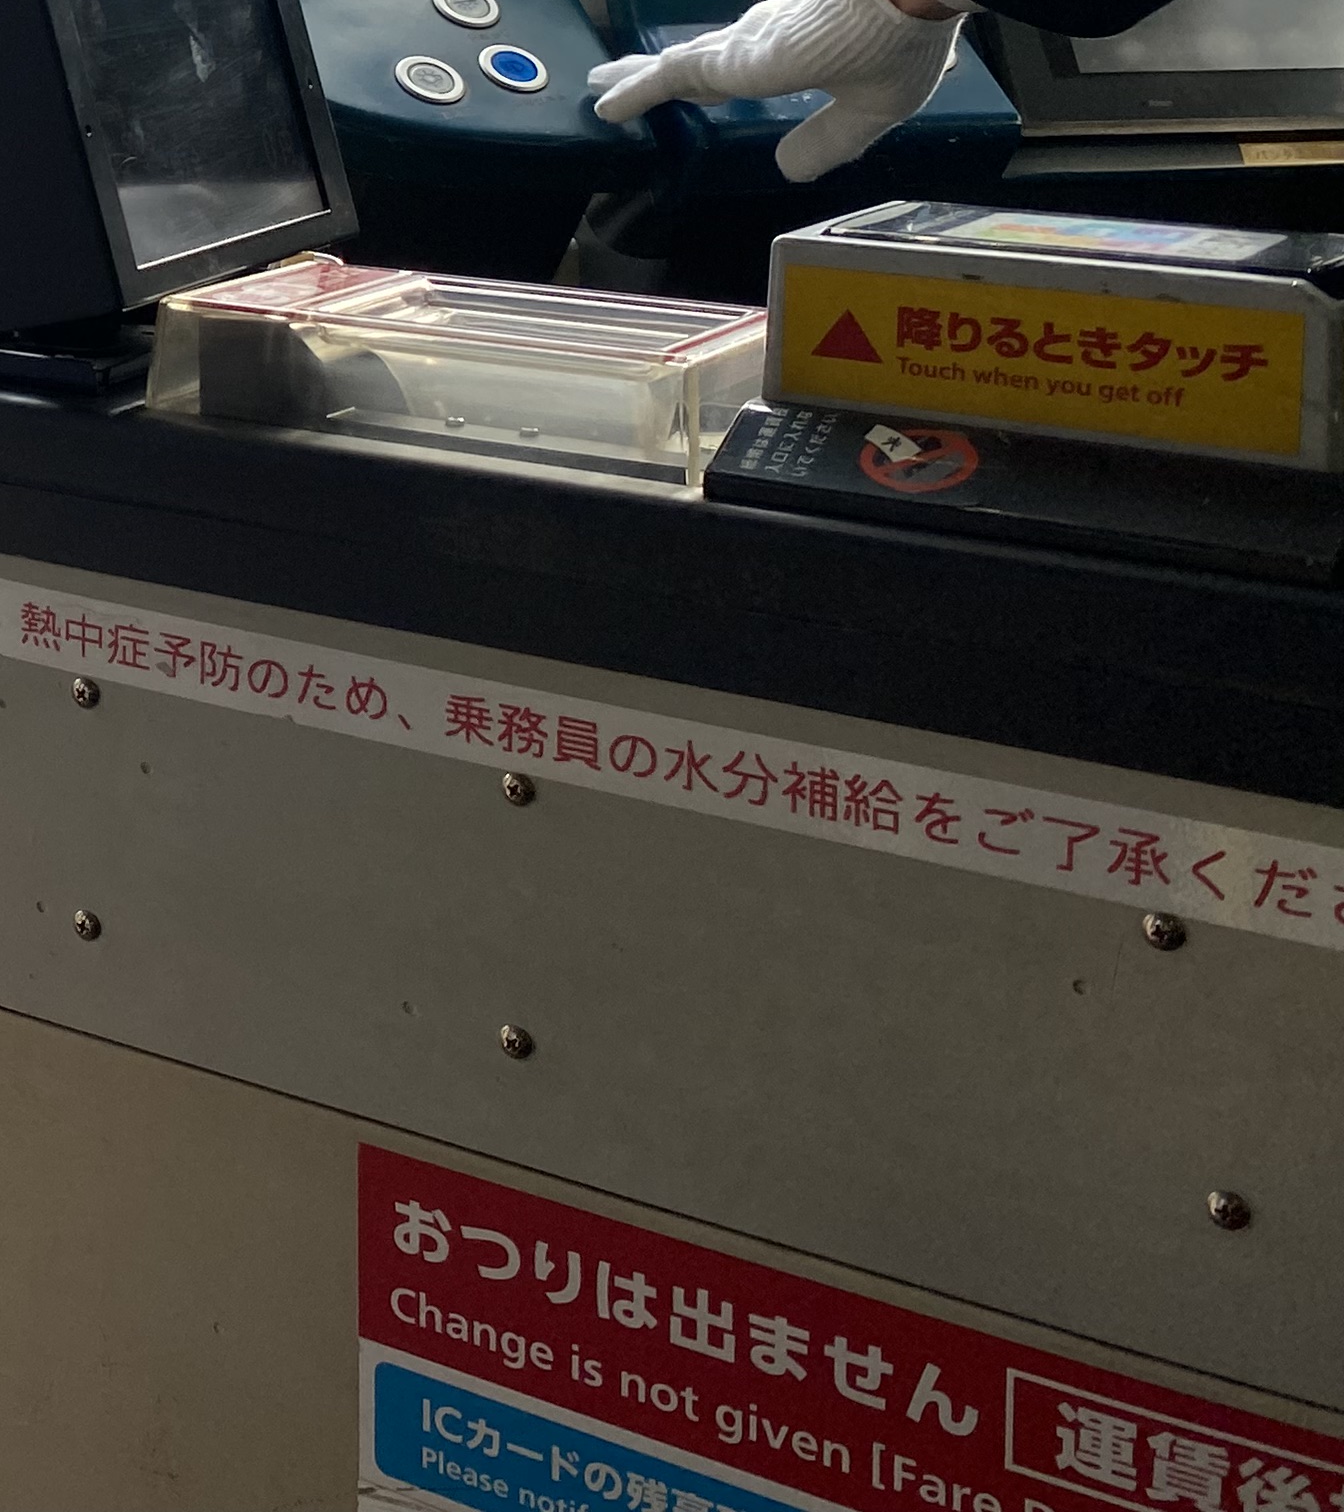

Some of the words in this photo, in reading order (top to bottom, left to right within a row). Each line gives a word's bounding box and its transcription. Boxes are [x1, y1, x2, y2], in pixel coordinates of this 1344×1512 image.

[896, 305, 1270, 382] 降りるときタッチ
[896, 355, 966, 382] Touch
[972, 366, 1040, 391] when
[1046, 376, 1092, 398] you
[1098, 381, 1141, 404] get
[1146, 387, 1186, 408] off
[21, 601, 1344, 926] 熱中症予防のため、乗務員の水分補給をご了承くだ
[389, 1287, 555, 1371] Change
[569, 1344, 605, 1388] is
[619, 1370, 700, 1423] not
[714, 1402, 852, 1475] given
[391, 1199, 980, 1437] おつりは出ません
[1054, 1401, 1344, 1512] 運賃後
[420, 1446, 510, 1499] Please
